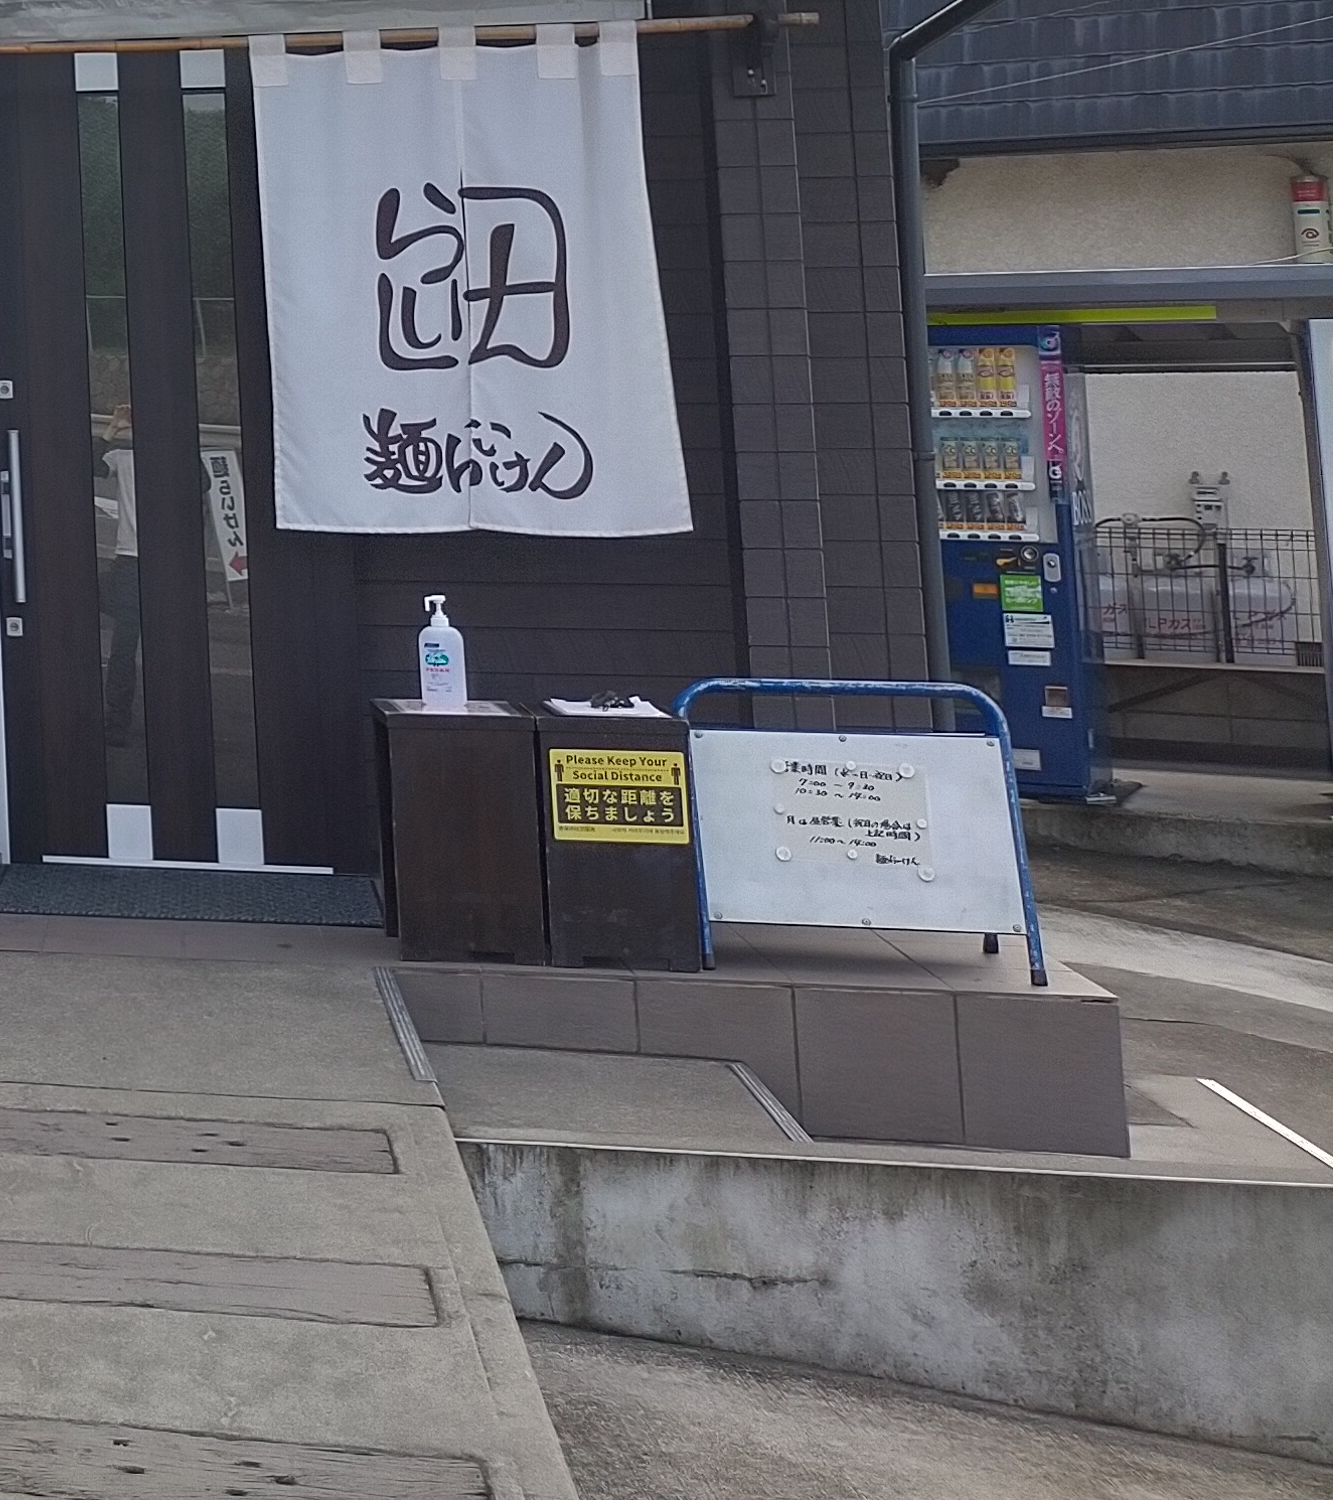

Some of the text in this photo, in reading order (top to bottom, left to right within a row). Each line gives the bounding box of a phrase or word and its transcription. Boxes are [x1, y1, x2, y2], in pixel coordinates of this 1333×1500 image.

[566, 755, 667, 767] Please Keep Your
[572, 770, 662, 782] Social Distance
[564, 787, 674, 806] 適切な距離を
[565, 805, 674, 823] 保ちましょう
